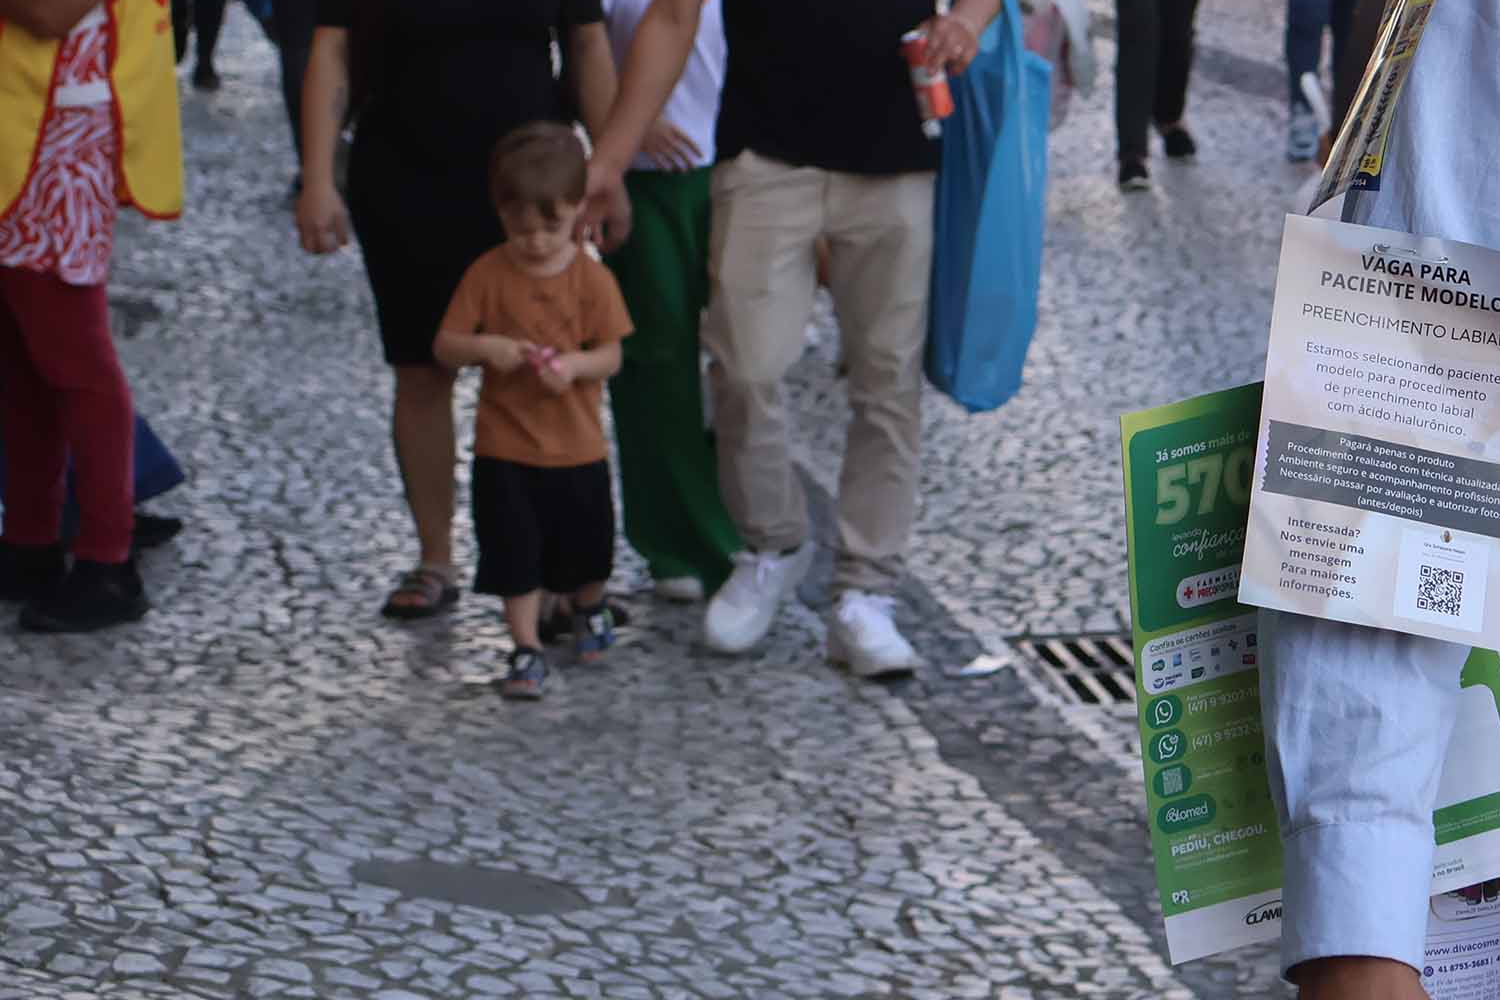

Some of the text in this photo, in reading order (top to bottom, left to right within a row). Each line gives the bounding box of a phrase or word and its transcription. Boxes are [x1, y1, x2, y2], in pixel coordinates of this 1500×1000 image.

[1319, 265, 1415, 303] PACIENTE
[1359, 252, 1472, 287] VAGA PARA
[1302, 299, 1446, 342] PREENCHIMENTO
[1305, 339, 1359, 362] Estamos
[1361, 349, 1444, 378] selecionando
[1315, 359, 1487, 406] modelo para procedimento
[1323, 379, 1474, 420] de preenchimento labial
[1326, 399, 1467, 437] com ácido hialurônico.
[1156, 432, 1234, 463] Já somos mais
[1287, 440, 1353, 464] Procedimento
[1354, 453, 1398, 471] realizado
[1399, 464, 1420, 476] com
[1421, 467, 1453, 483] técnica
[1338, 436, 1370, 455] Pagará
[1371, 444, 1407, 461] apenas
[1416, 452, 1455, 470] produto
[1278, 452, 1325, 471] Ambiente
[1325, 463, 1359, 479] seguro
[1367, 469, 1452, 498] acompanhamento
[1279, 465, 1332, 486] Necessário
[1333, 478, 1363, 493] passar
[1365, 484, 1382, 497] por
[1383, 486, 1427, 507] avaliação
[1435, 498, 1479, 515] autorizar
[1356, 494, 1424, 519] (antes/depois)
[1279, 529, 1365, 556] Nos envie uma
[1287, 514, 1361, 539] Interessada?
[1172, 528, 1245, 560] confiança
[1287, 547, 1352, 571] mensagem
[1278, 576, 1355, 603] informações.
[1280, 561, 1357, 586] Para maiores
[1171, 824, 1266, 857] PEDIU, CHEGOU.
